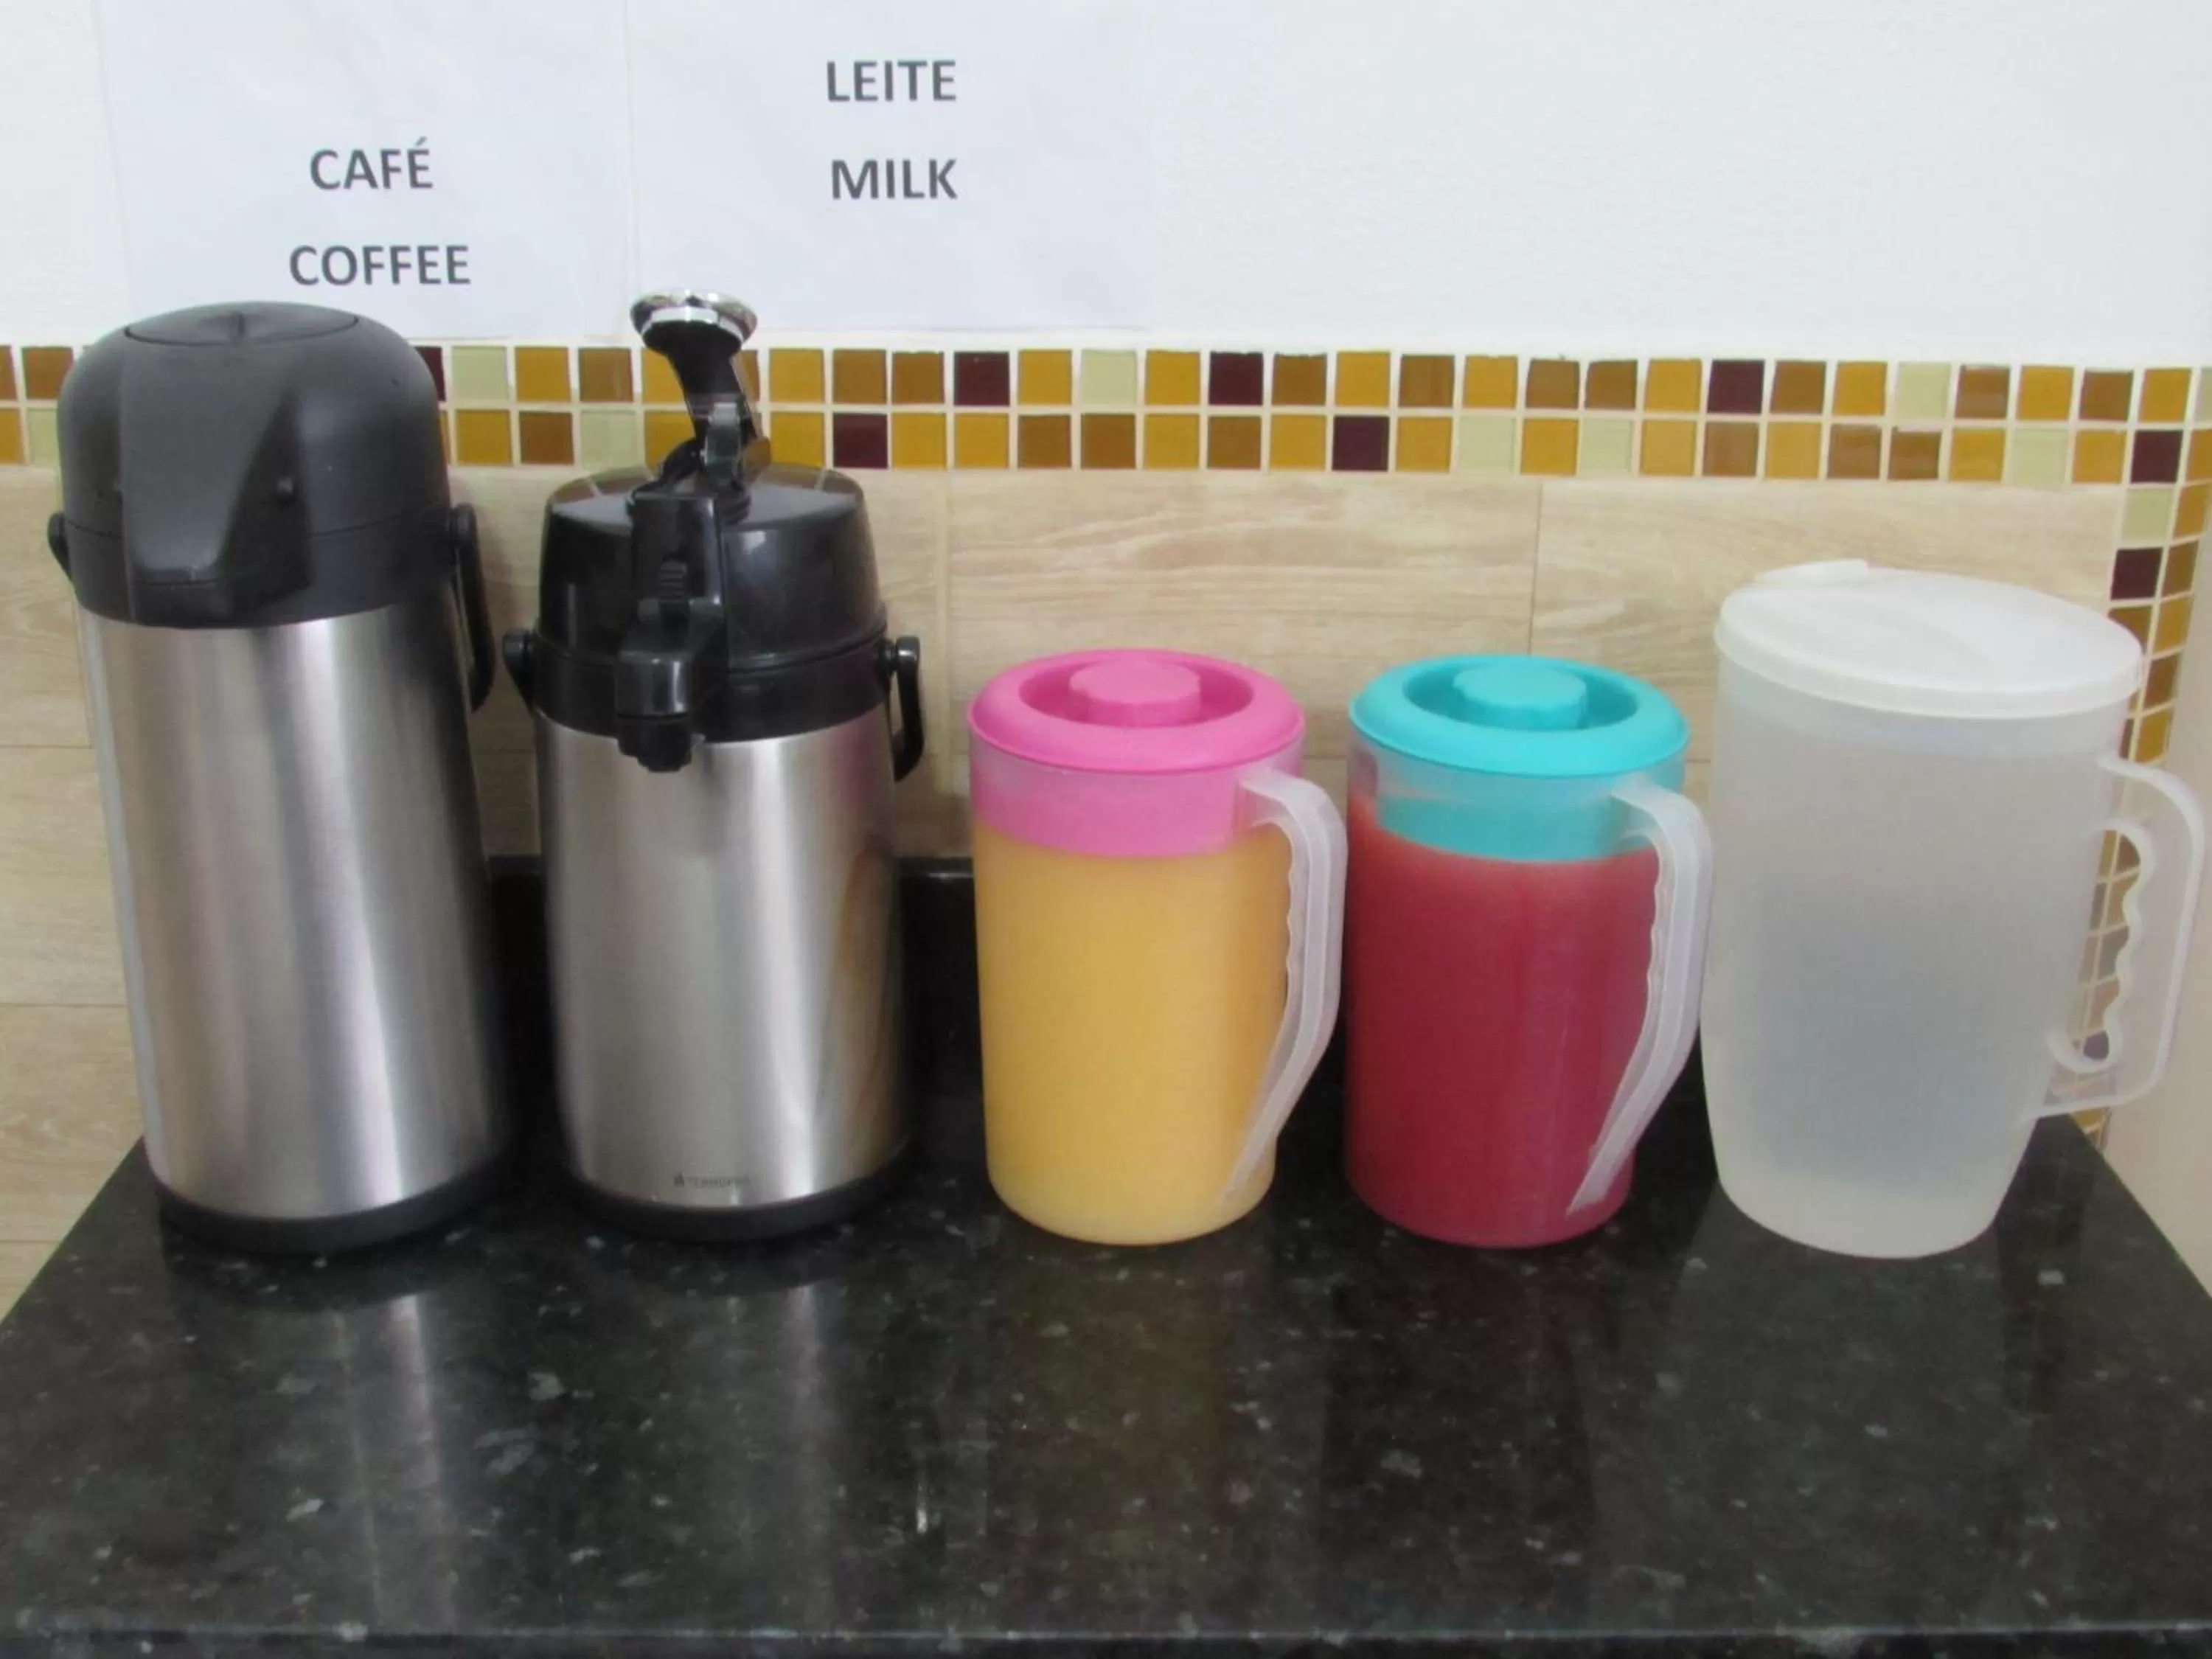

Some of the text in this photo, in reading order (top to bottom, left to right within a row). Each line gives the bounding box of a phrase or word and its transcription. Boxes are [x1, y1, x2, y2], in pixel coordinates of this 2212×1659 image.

[826, 60, 956, 103] LEITE
[310, 137, 434, 190] CAFÉ
[830, 159, 959, 201] MILK
[289, 245, 471, 286] COFFEE
